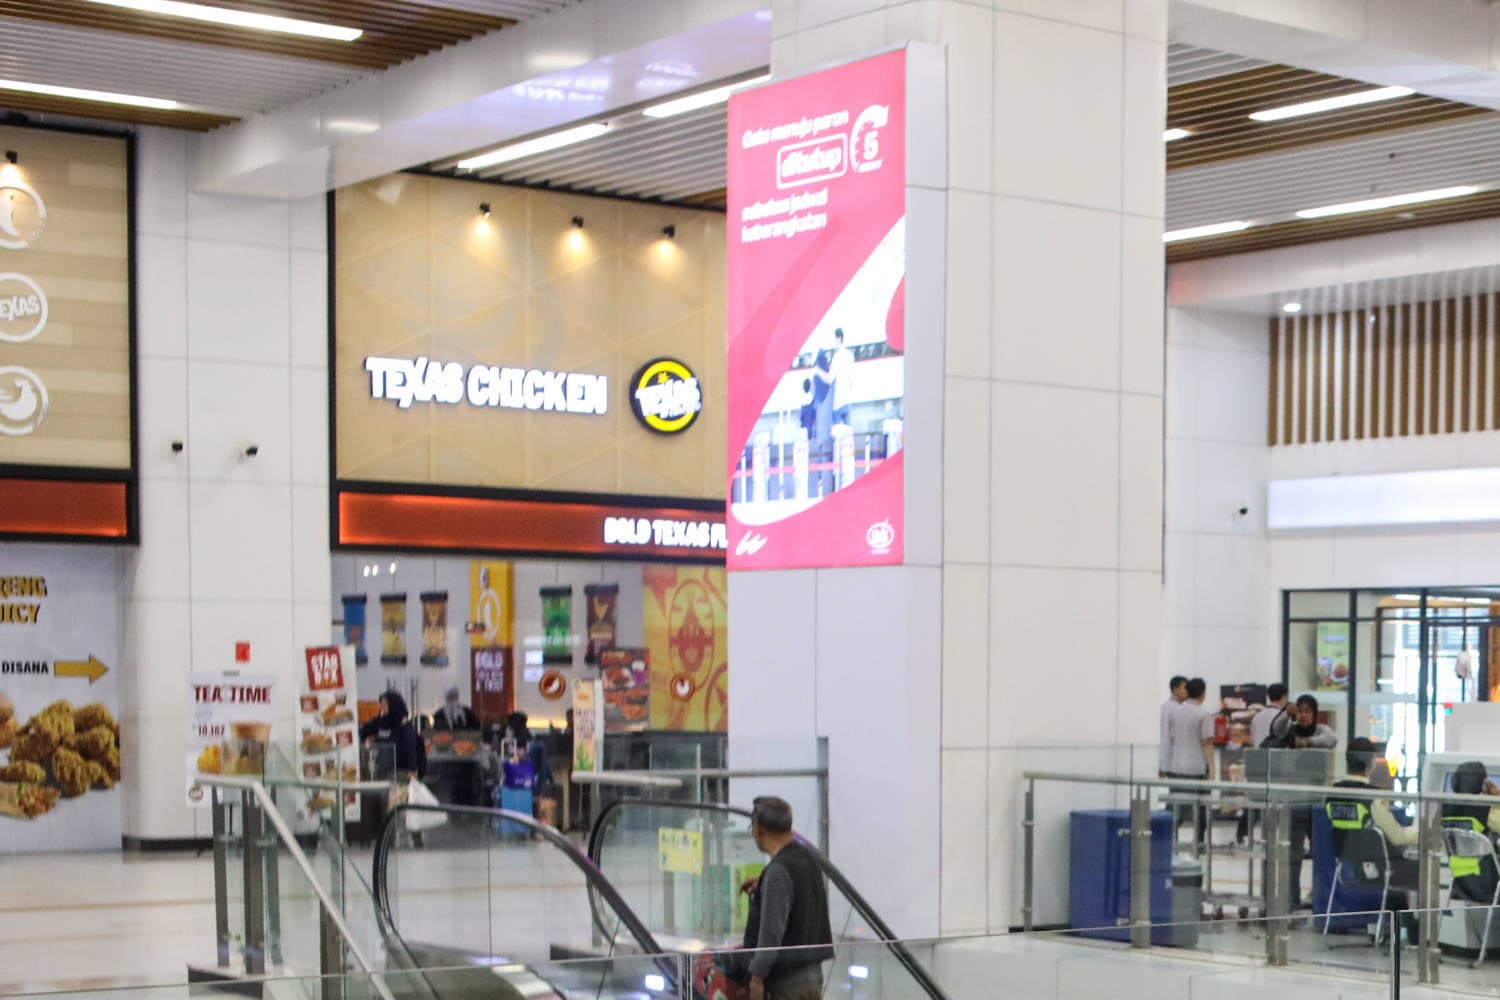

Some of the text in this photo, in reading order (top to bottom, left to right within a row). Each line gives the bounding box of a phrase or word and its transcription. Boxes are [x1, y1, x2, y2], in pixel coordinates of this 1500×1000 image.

[364, 356, 608, 415] TEXAS CHICKEN
[2, 661, 49, 675] DISANA
[194, 685, 272, 704] TEA TIME
